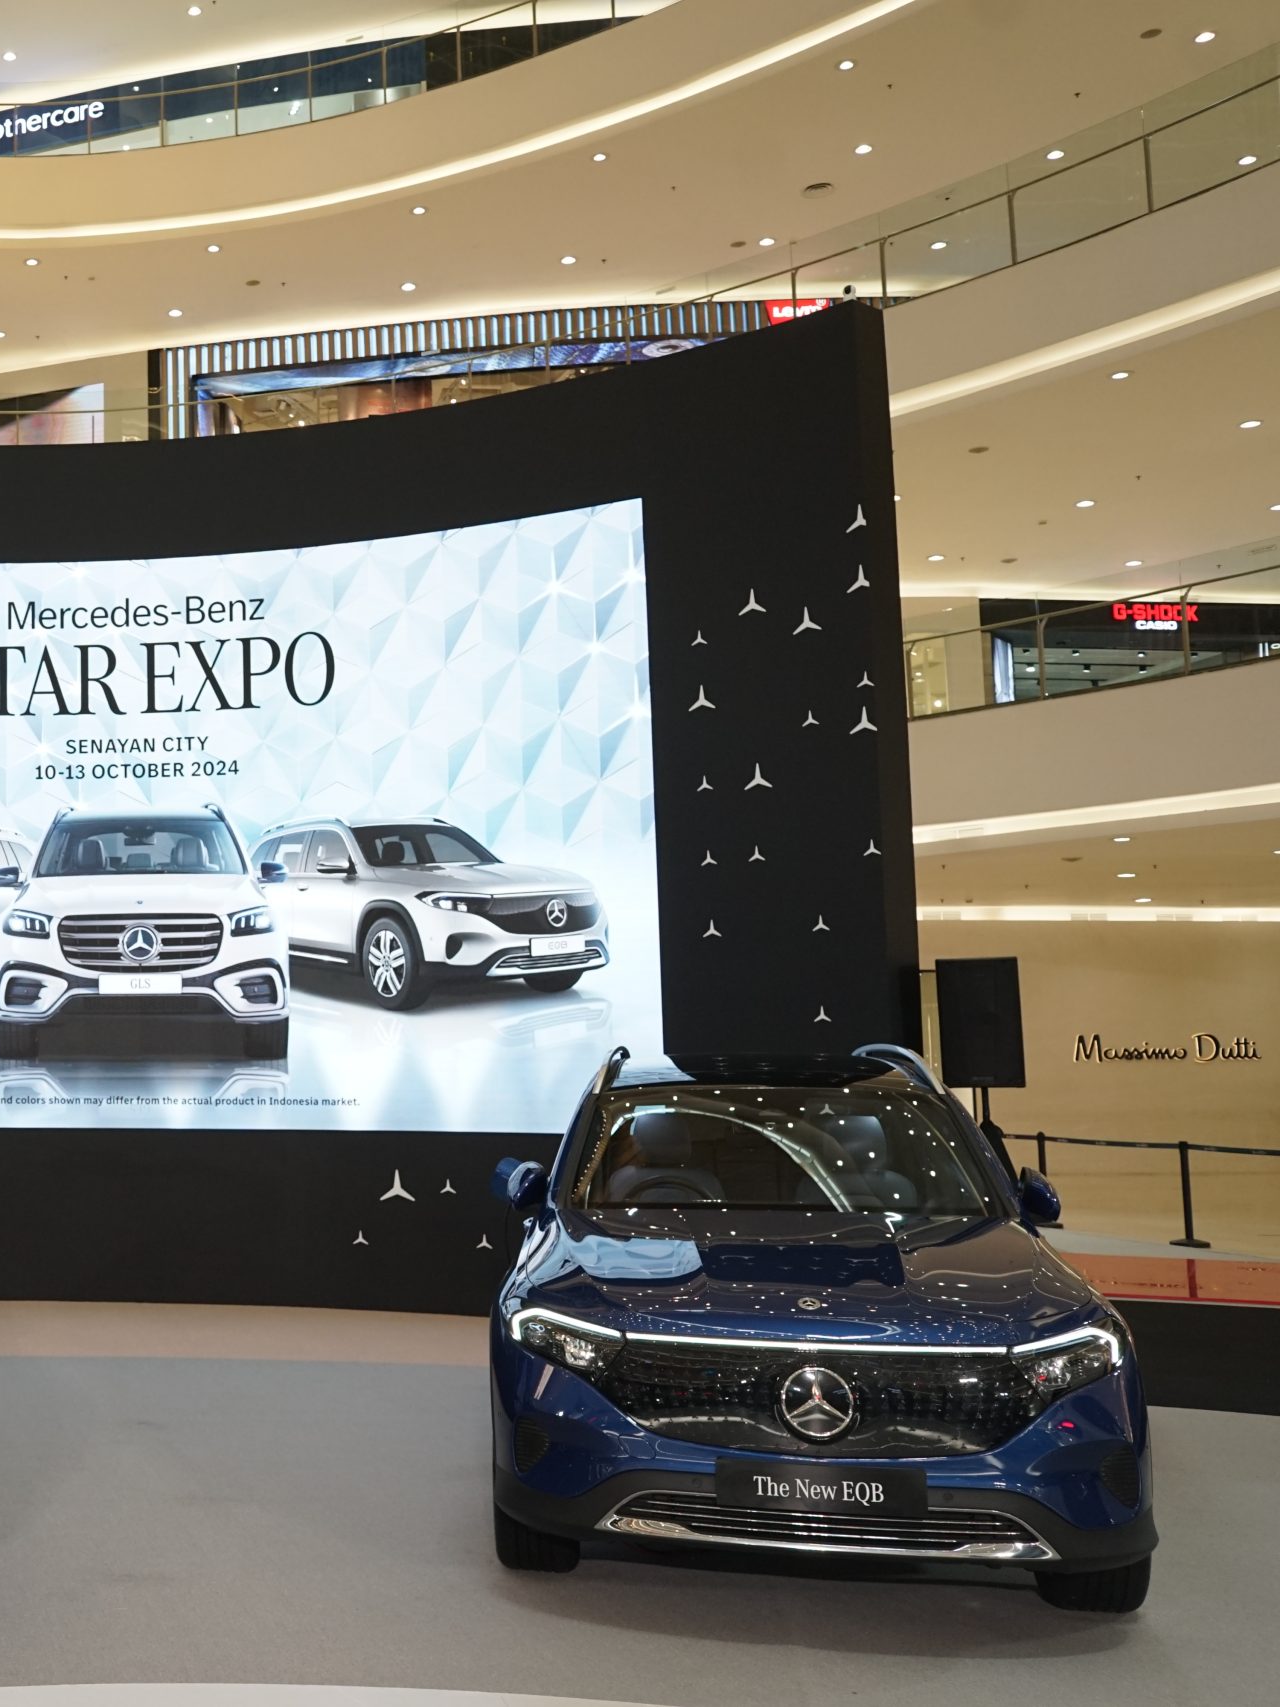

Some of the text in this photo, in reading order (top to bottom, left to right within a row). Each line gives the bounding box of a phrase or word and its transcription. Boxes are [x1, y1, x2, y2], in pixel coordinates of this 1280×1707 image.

[7, 595, 265, 630] Mercedes-Benz
[1112, 603, 1199, 622] G-SHOCK
[1135, 620, 1178, 631] CASIO
[140, 631, 336, 713] EXPO
[66, 736, 209, 755] SENAYAN CITY
[34, 760, 240, 780] 10-13 OCTOBER 2024
[130, 978, 151, 989] GLS
[1073, 1033, 1262, 1063] Massimo Dutti
[15, 1095, 46, 1105] colors
[48, 1095, 81, 1105] shown
[83, 1097, 104, 1107] may
[106, 1095, 134, 1105] differ
[136, 1095, 160, 1105] from
[162, 1095, 179, 1105] the
[181, 1095, 213, 1106] actual
[215, 1096, 255, 1107] product
[257, 1096, 267, 1106] in
[269, 1096, 319, 1106] Indonesia
[321, 1096, 361, 1107] market.
[753, 1475, 885, 1506] The New EQB
